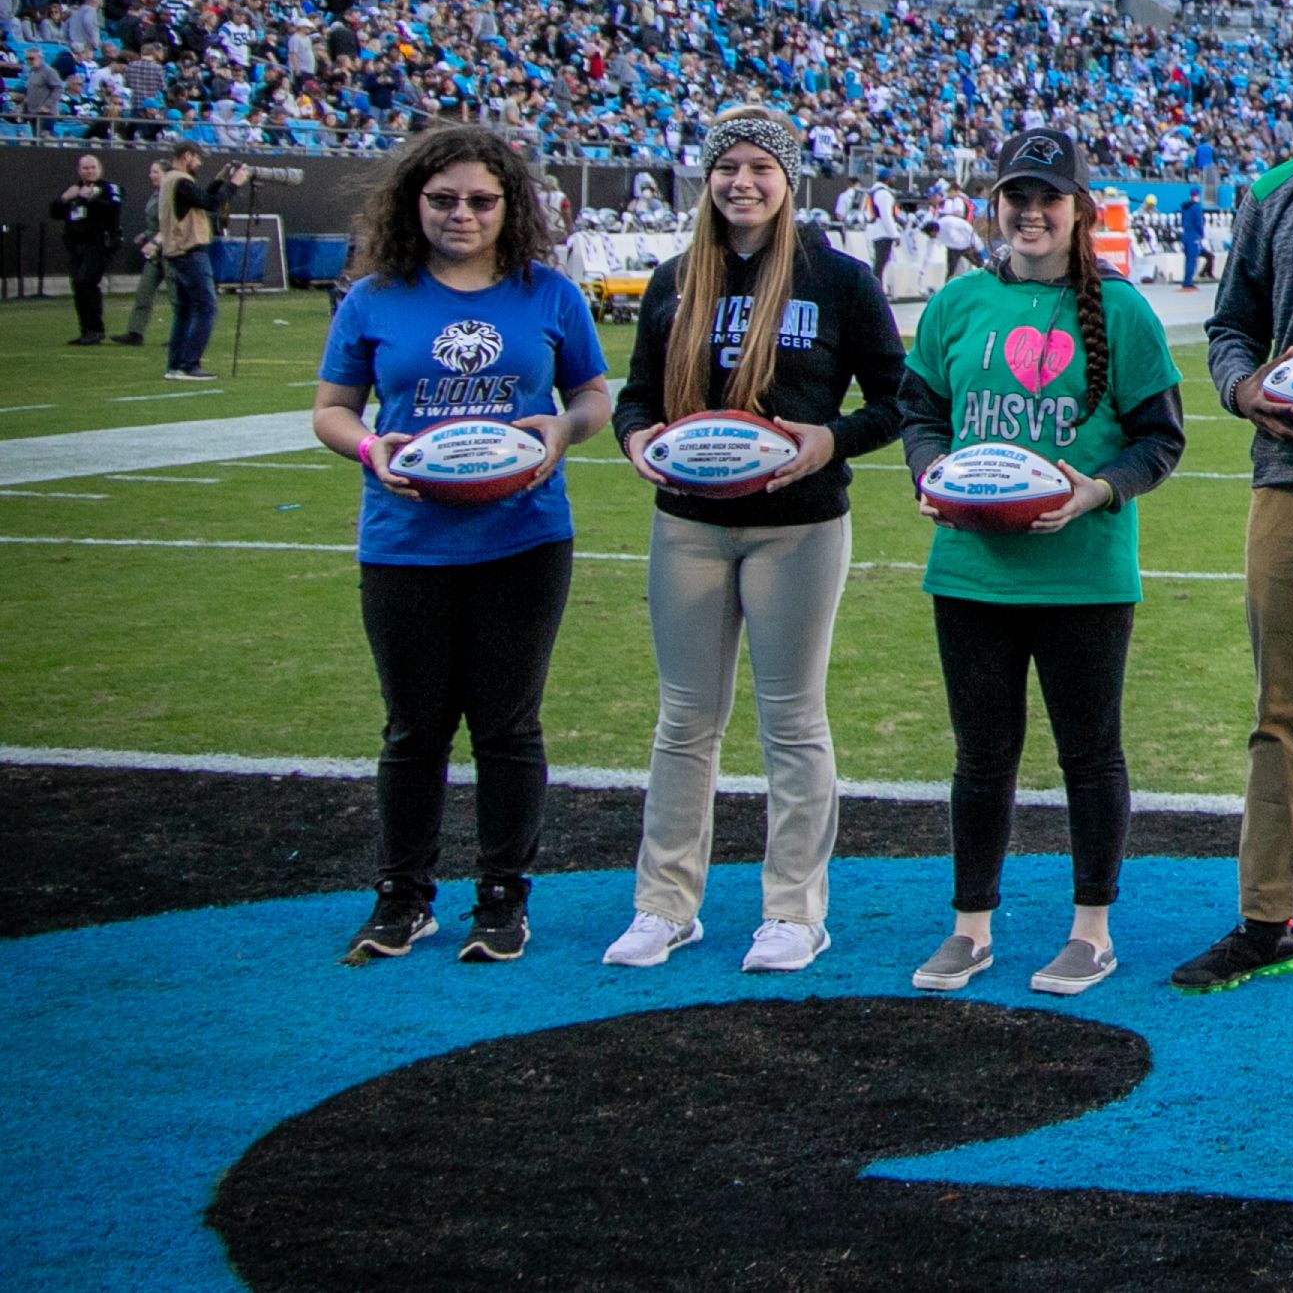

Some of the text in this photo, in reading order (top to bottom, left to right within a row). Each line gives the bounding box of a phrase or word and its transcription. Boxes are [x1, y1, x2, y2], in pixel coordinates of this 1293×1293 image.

[983, 331, 997, 370] I
[414, 376, 519, 406] LIONS
[413, 403, 513, 417] SWIMMING
[959, 390, 1079, 447] AHSVB
[457, 462, 489, 474] 2019
[698, 466, 729, 477] 2019
[967, 483, 997, 495] 2019
